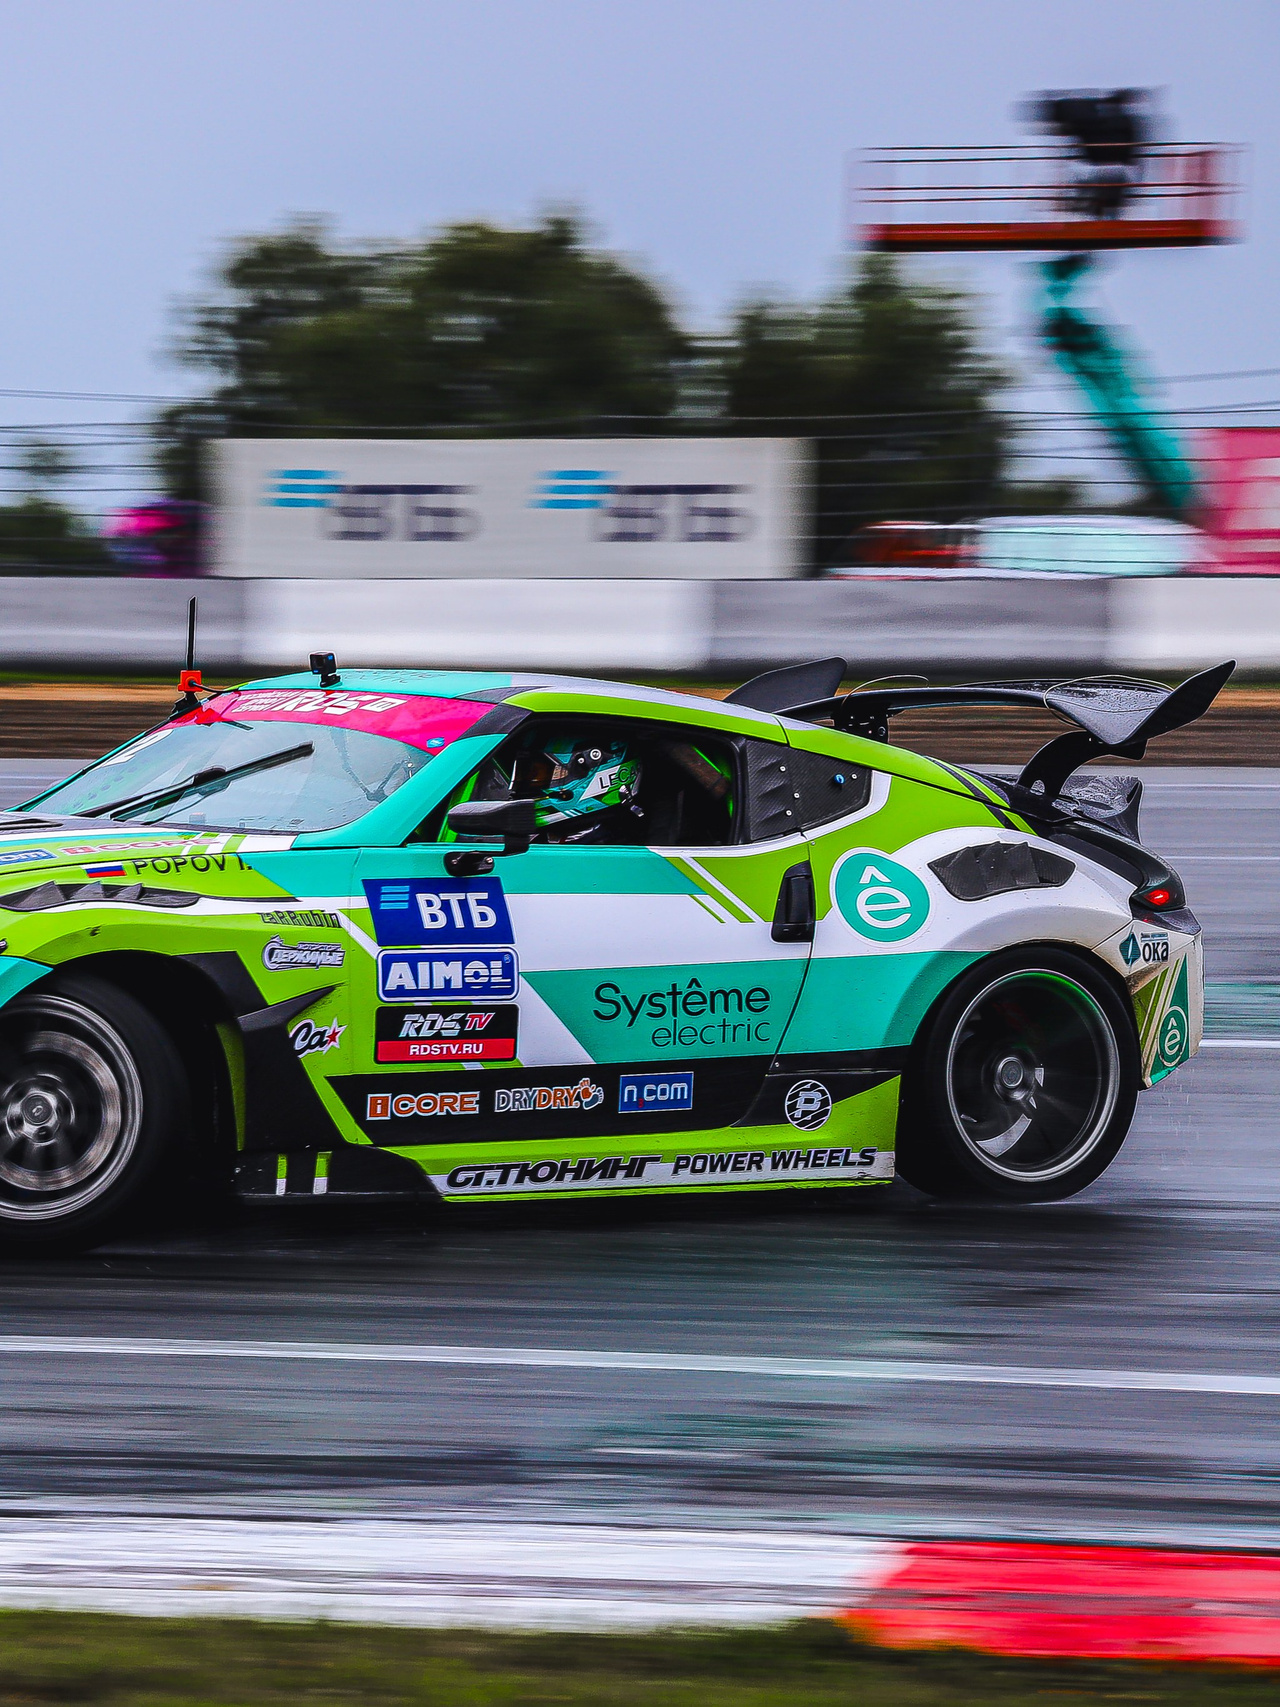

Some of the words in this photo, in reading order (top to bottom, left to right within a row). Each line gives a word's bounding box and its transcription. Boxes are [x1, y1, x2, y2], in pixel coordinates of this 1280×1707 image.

[416, 893, 497, 929] ВТБ
[385, 961, 511, 990] AIMOL
[651, 1018, 770, 1047] electric
[409, 1043, 484, 1057] RDSTV.RU
[672, 1152, 763, 1176] POWER
[770, 1148, 876, 1171] WHEELS
